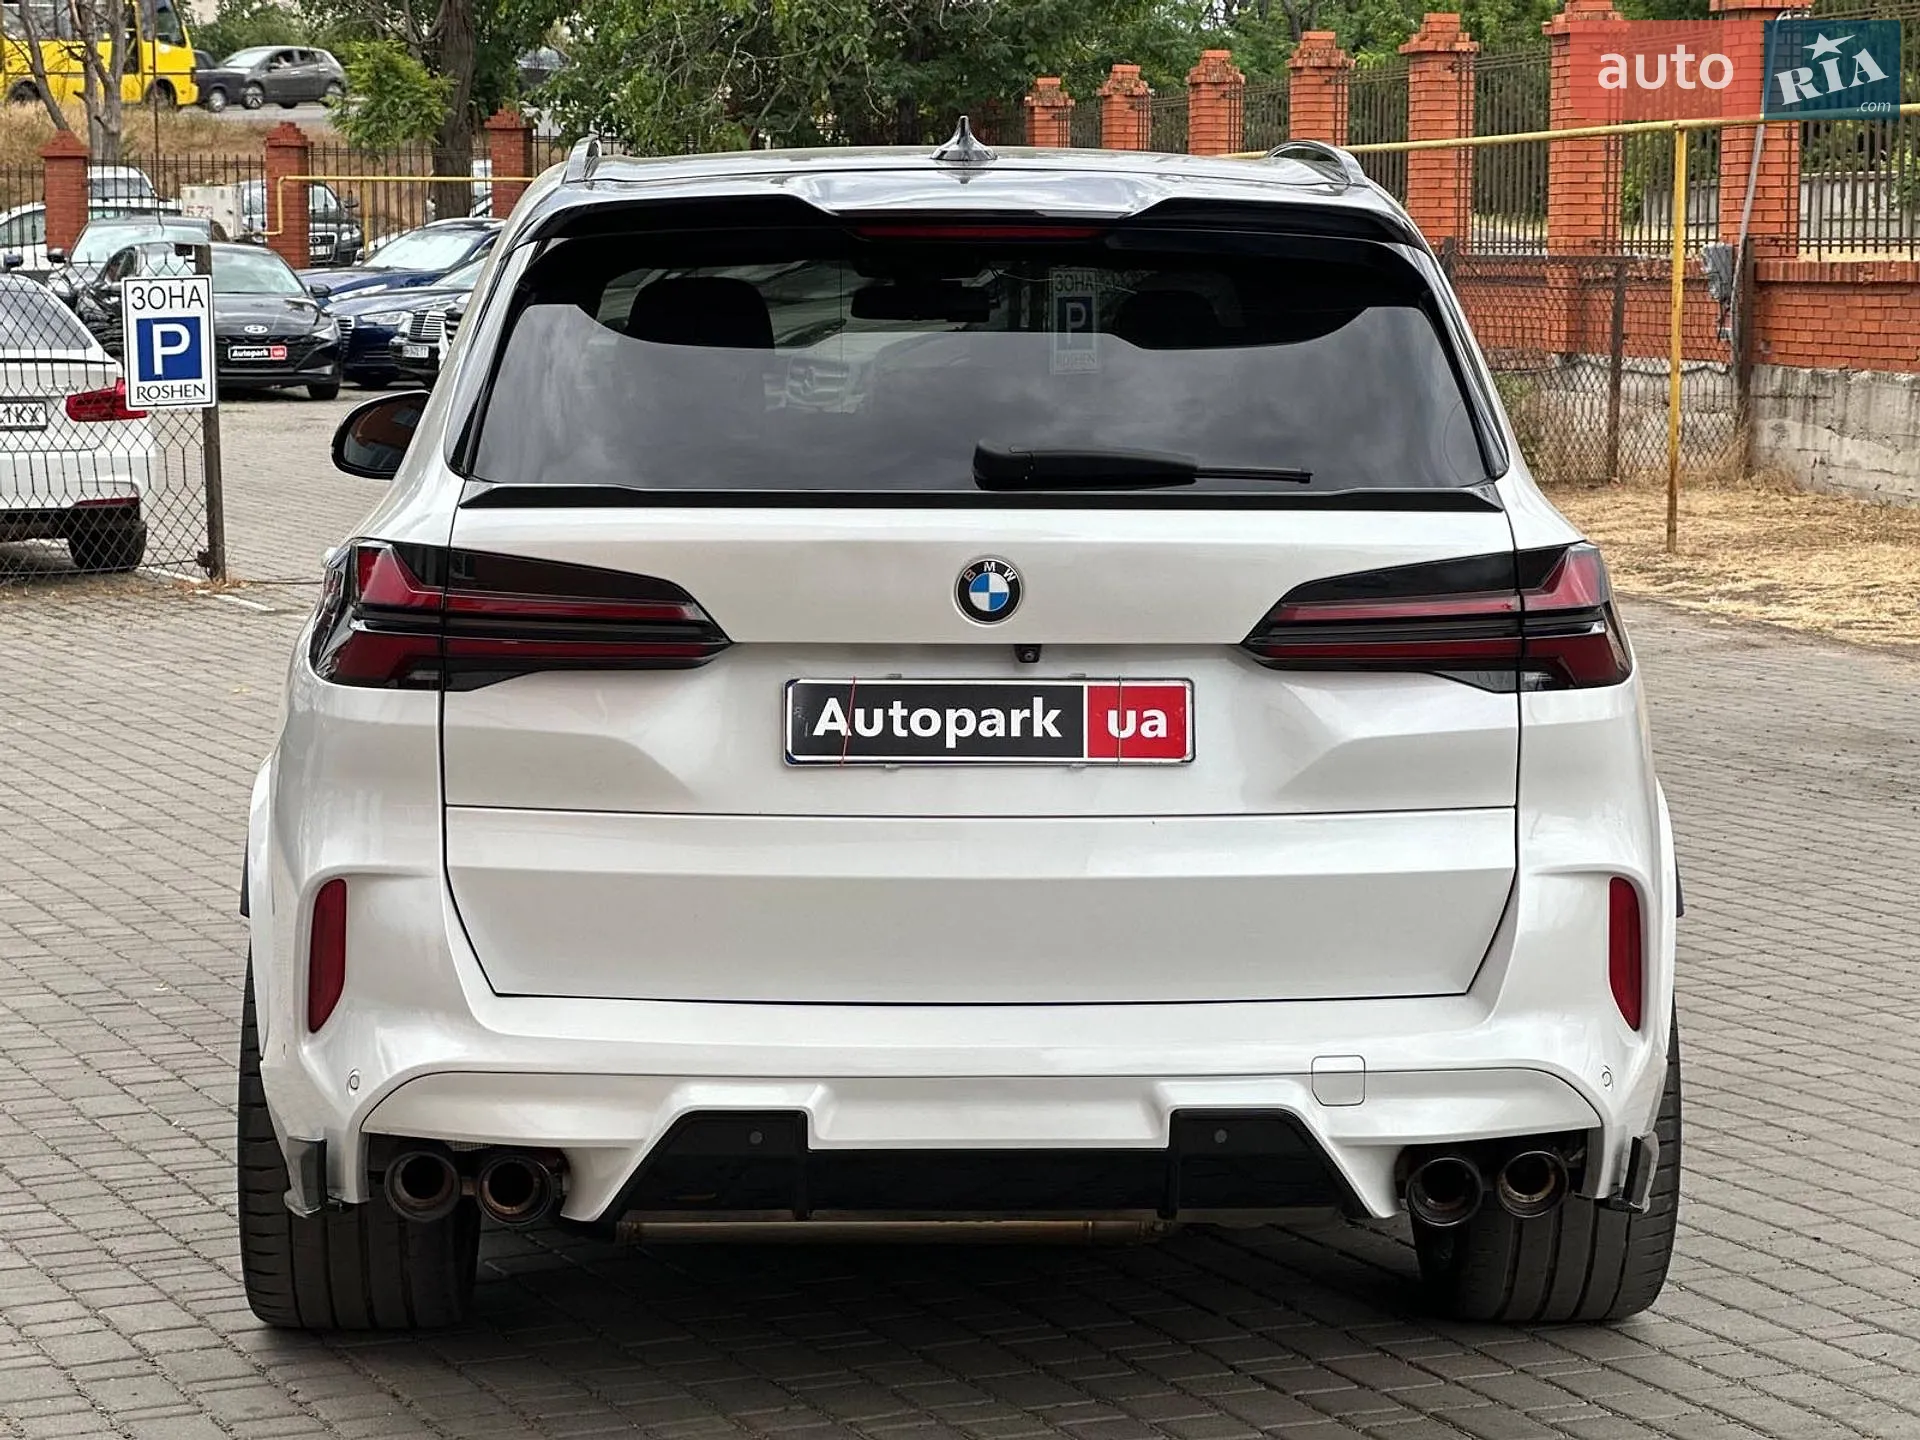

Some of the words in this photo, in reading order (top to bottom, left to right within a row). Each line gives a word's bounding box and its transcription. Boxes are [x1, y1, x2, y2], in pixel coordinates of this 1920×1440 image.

[131, 286, 204, 311] ЗОНА
[136, 383, 206, 402] ROSHEN
[964, 561, 1017, 582] BMW
[812, 696, 1063, 749] Autopark
[1106, 707, 1168, 739] ua
